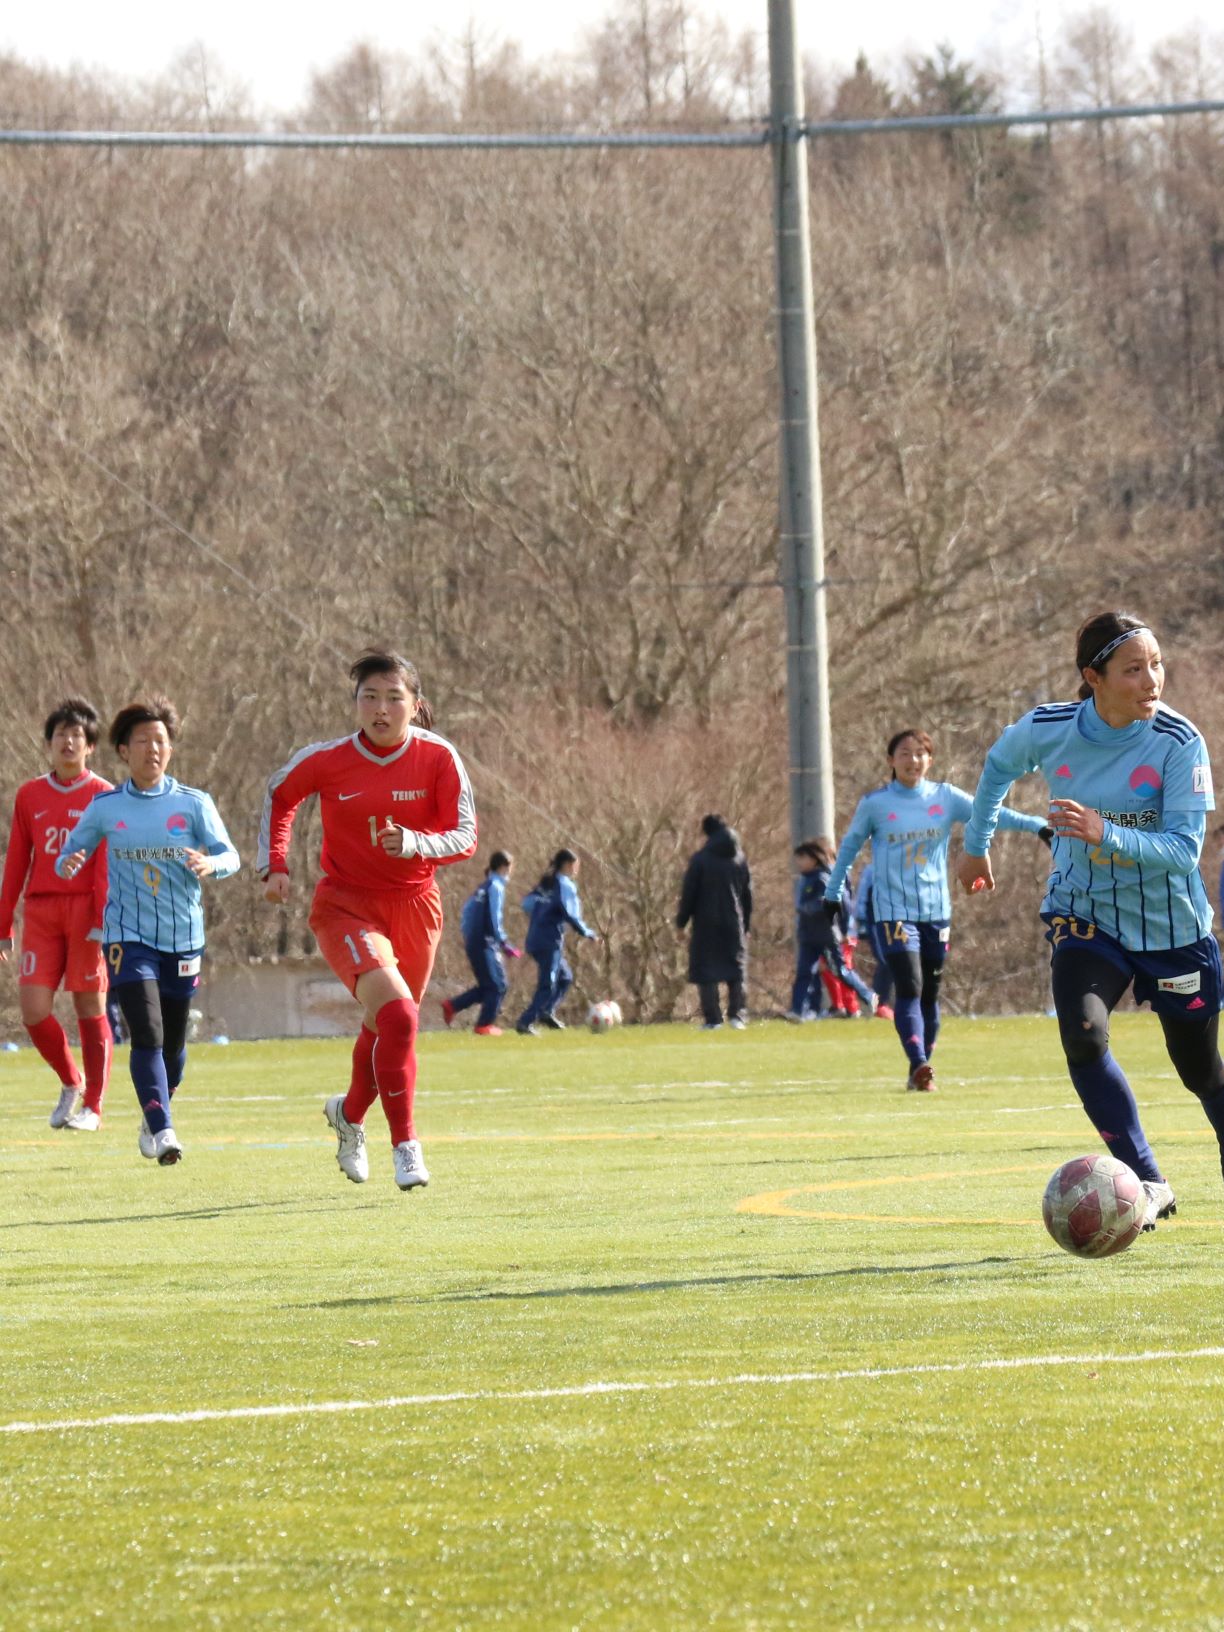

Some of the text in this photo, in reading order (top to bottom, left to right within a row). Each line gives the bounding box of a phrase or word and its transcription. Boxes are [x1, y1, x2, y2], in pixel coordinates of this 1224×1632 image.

[143, 864, 161, 896] 9
[883, 921, 909, 945] 14
[109, 943, 123, 976] 9
